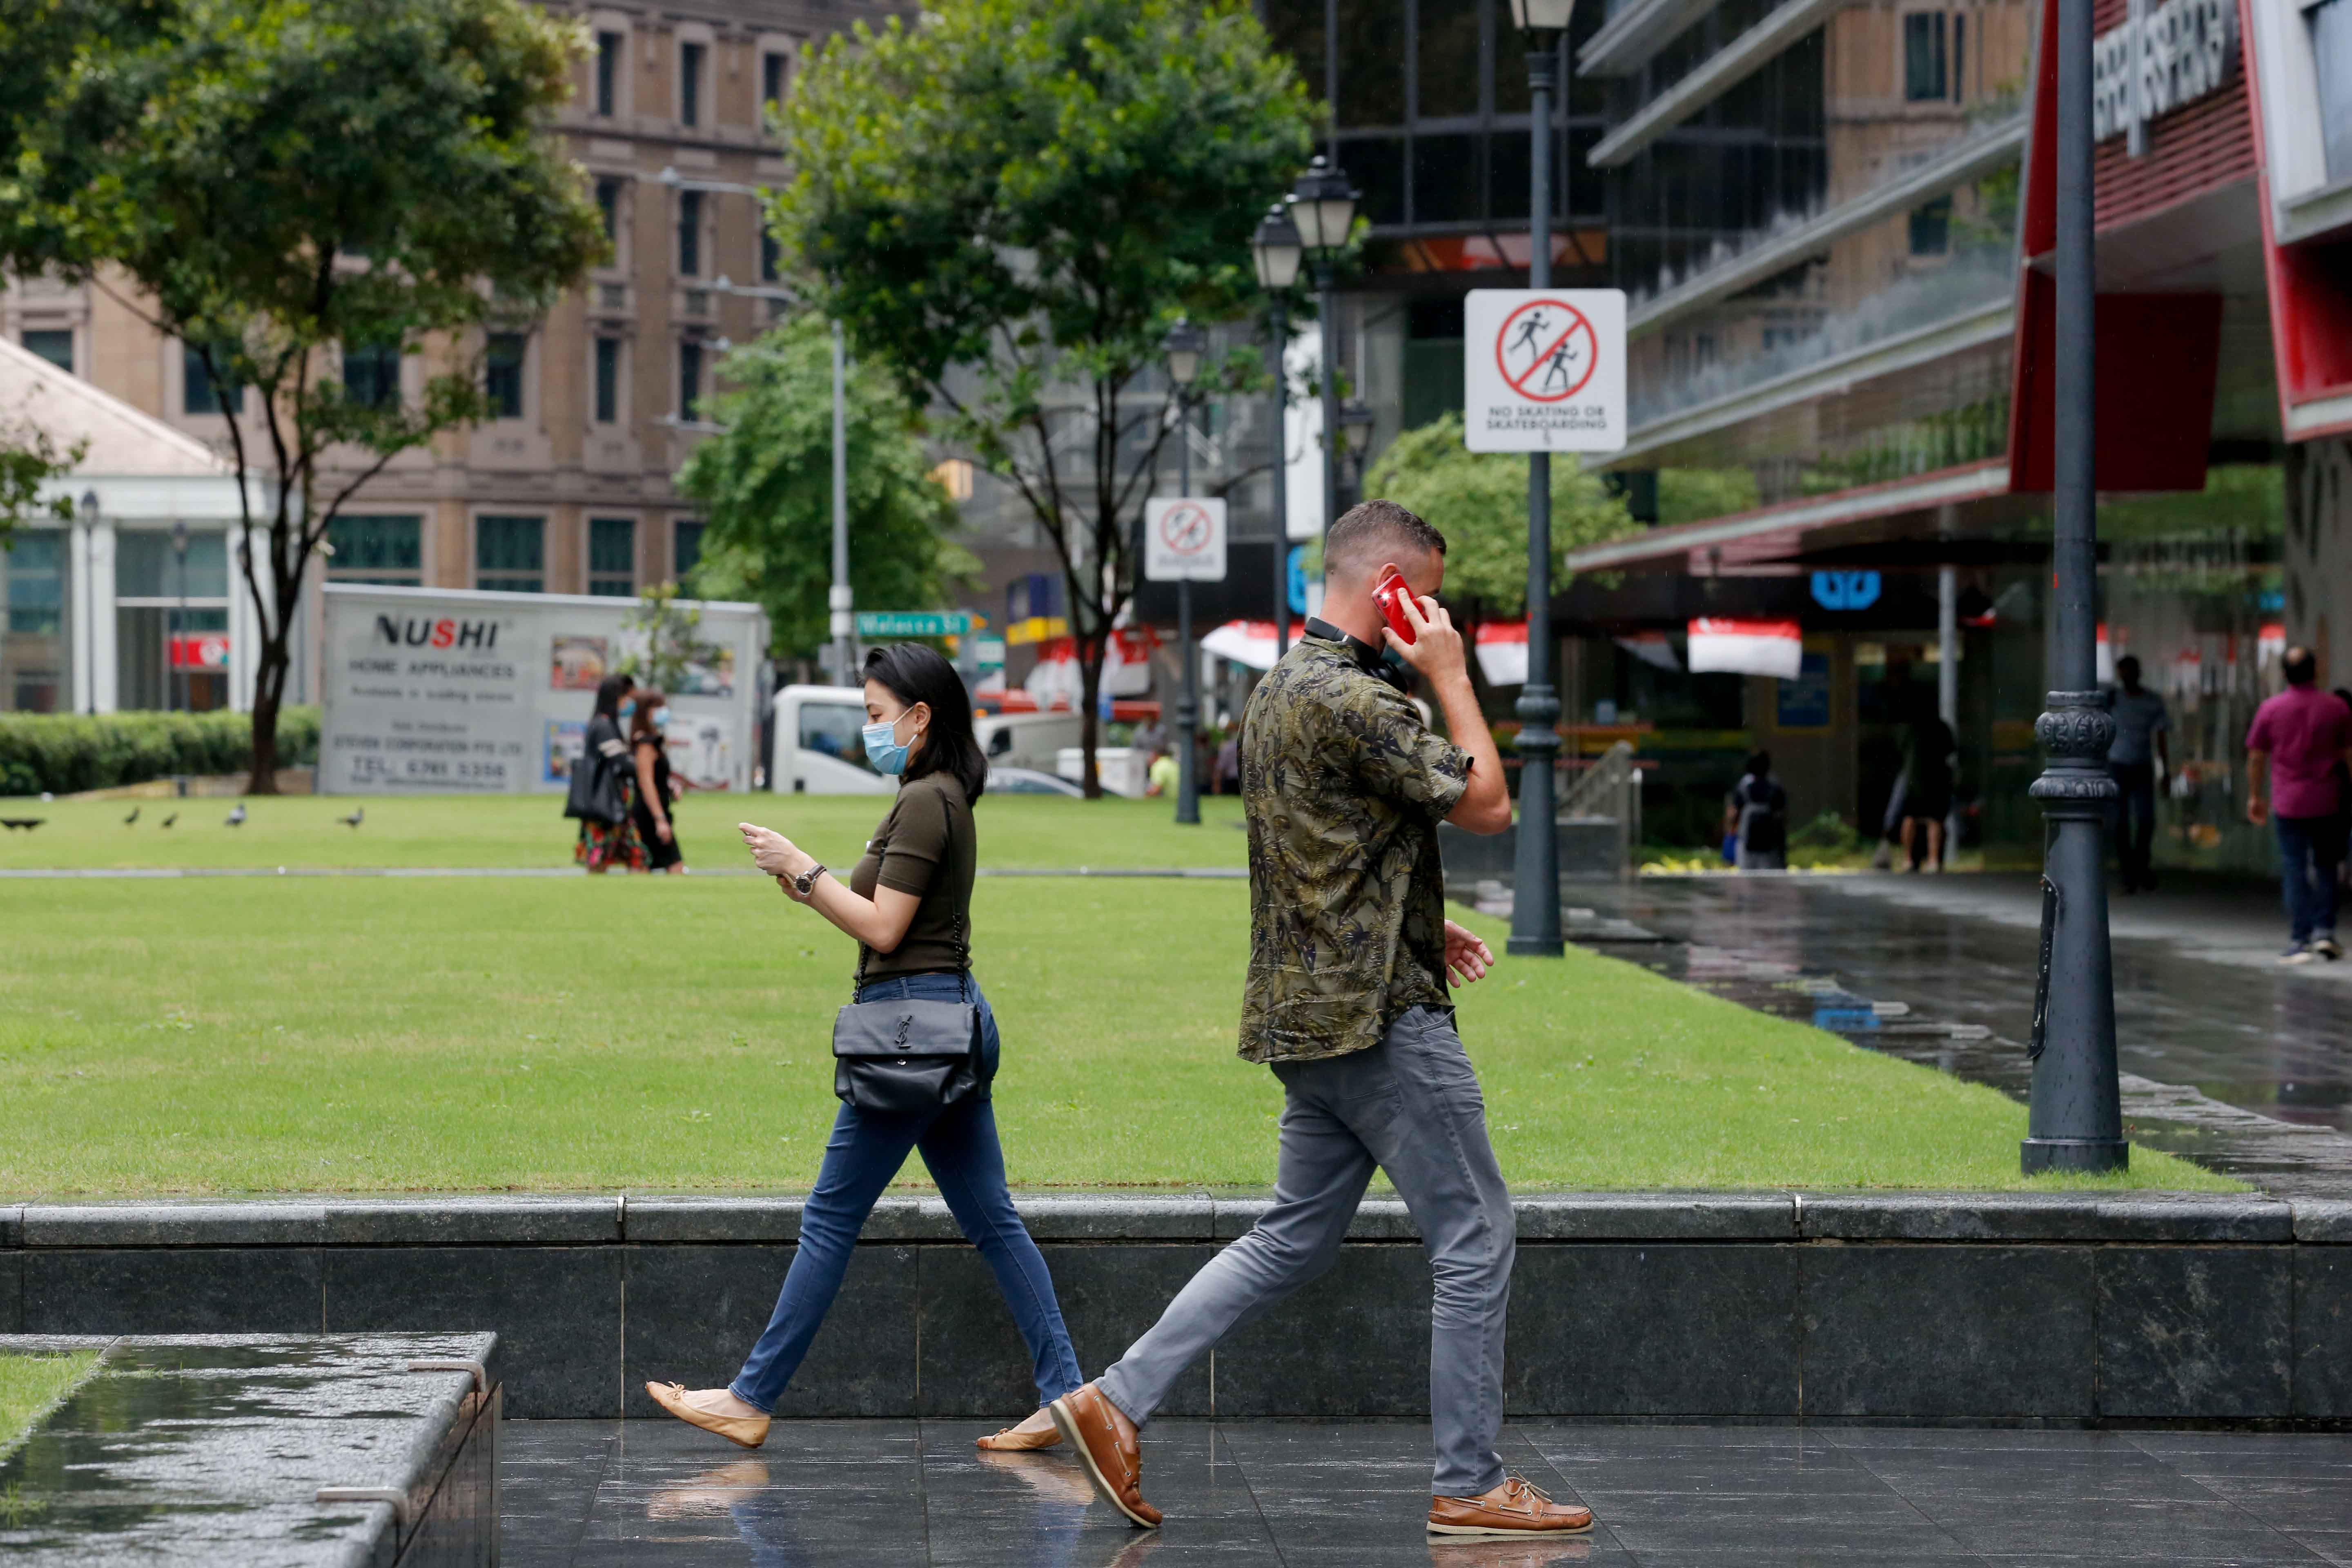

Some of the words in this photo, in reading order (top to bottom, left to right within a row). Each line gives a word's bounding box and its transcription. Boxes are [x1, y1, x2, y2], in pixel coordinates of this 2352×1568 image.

[1489, 407, 1512, 416] NO
[1517, 407, 1579, 416] SKATING
[1584, 407, 1605, 416] OR
[1486, 419, 1608, 430] SKATEBOARDING
[374, 614, 497, 648] NUSHI
[350, 660, 397, 675] HOME
[410, 661, 515, 678] APPLIANCES
